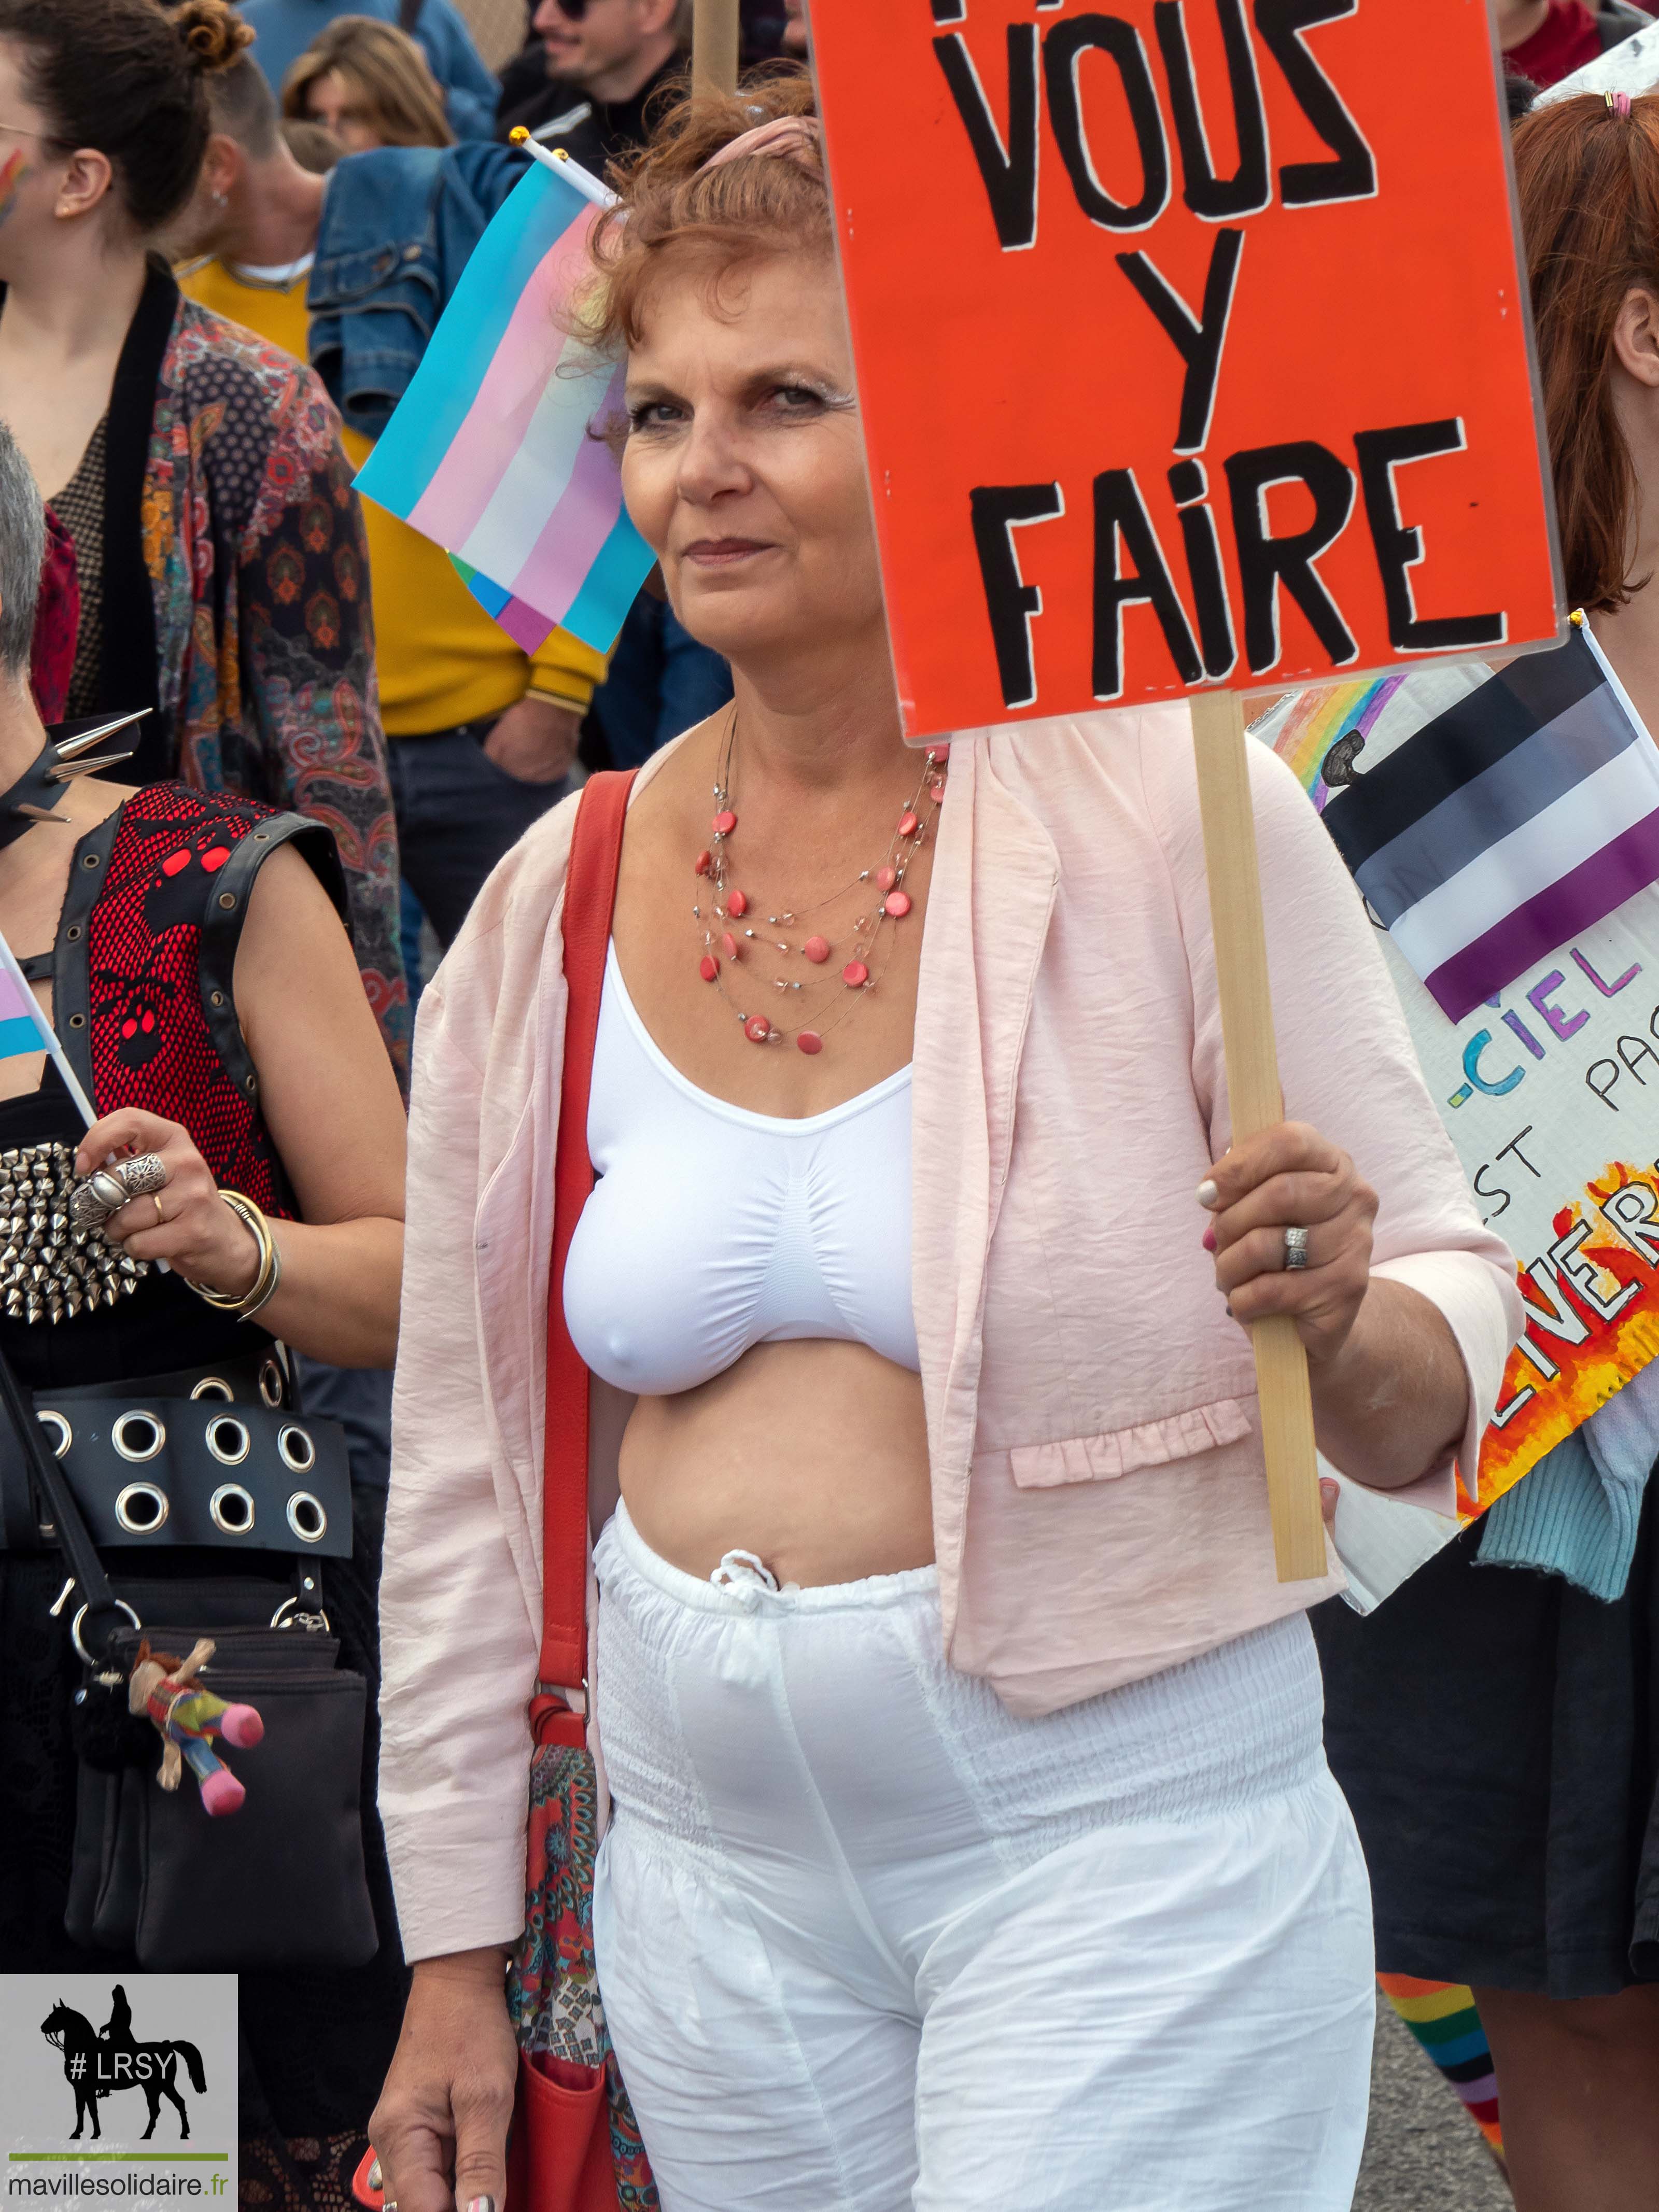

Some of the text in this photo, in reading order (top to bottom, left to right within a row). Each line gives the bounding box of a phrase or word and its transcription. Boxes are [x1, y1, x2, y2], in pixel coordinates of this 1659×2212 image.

[932, 0, 1378, 252] VOUS
[1115, 228, 1245, 456] Y
[1473, 1124, 1542, 1226] ST
